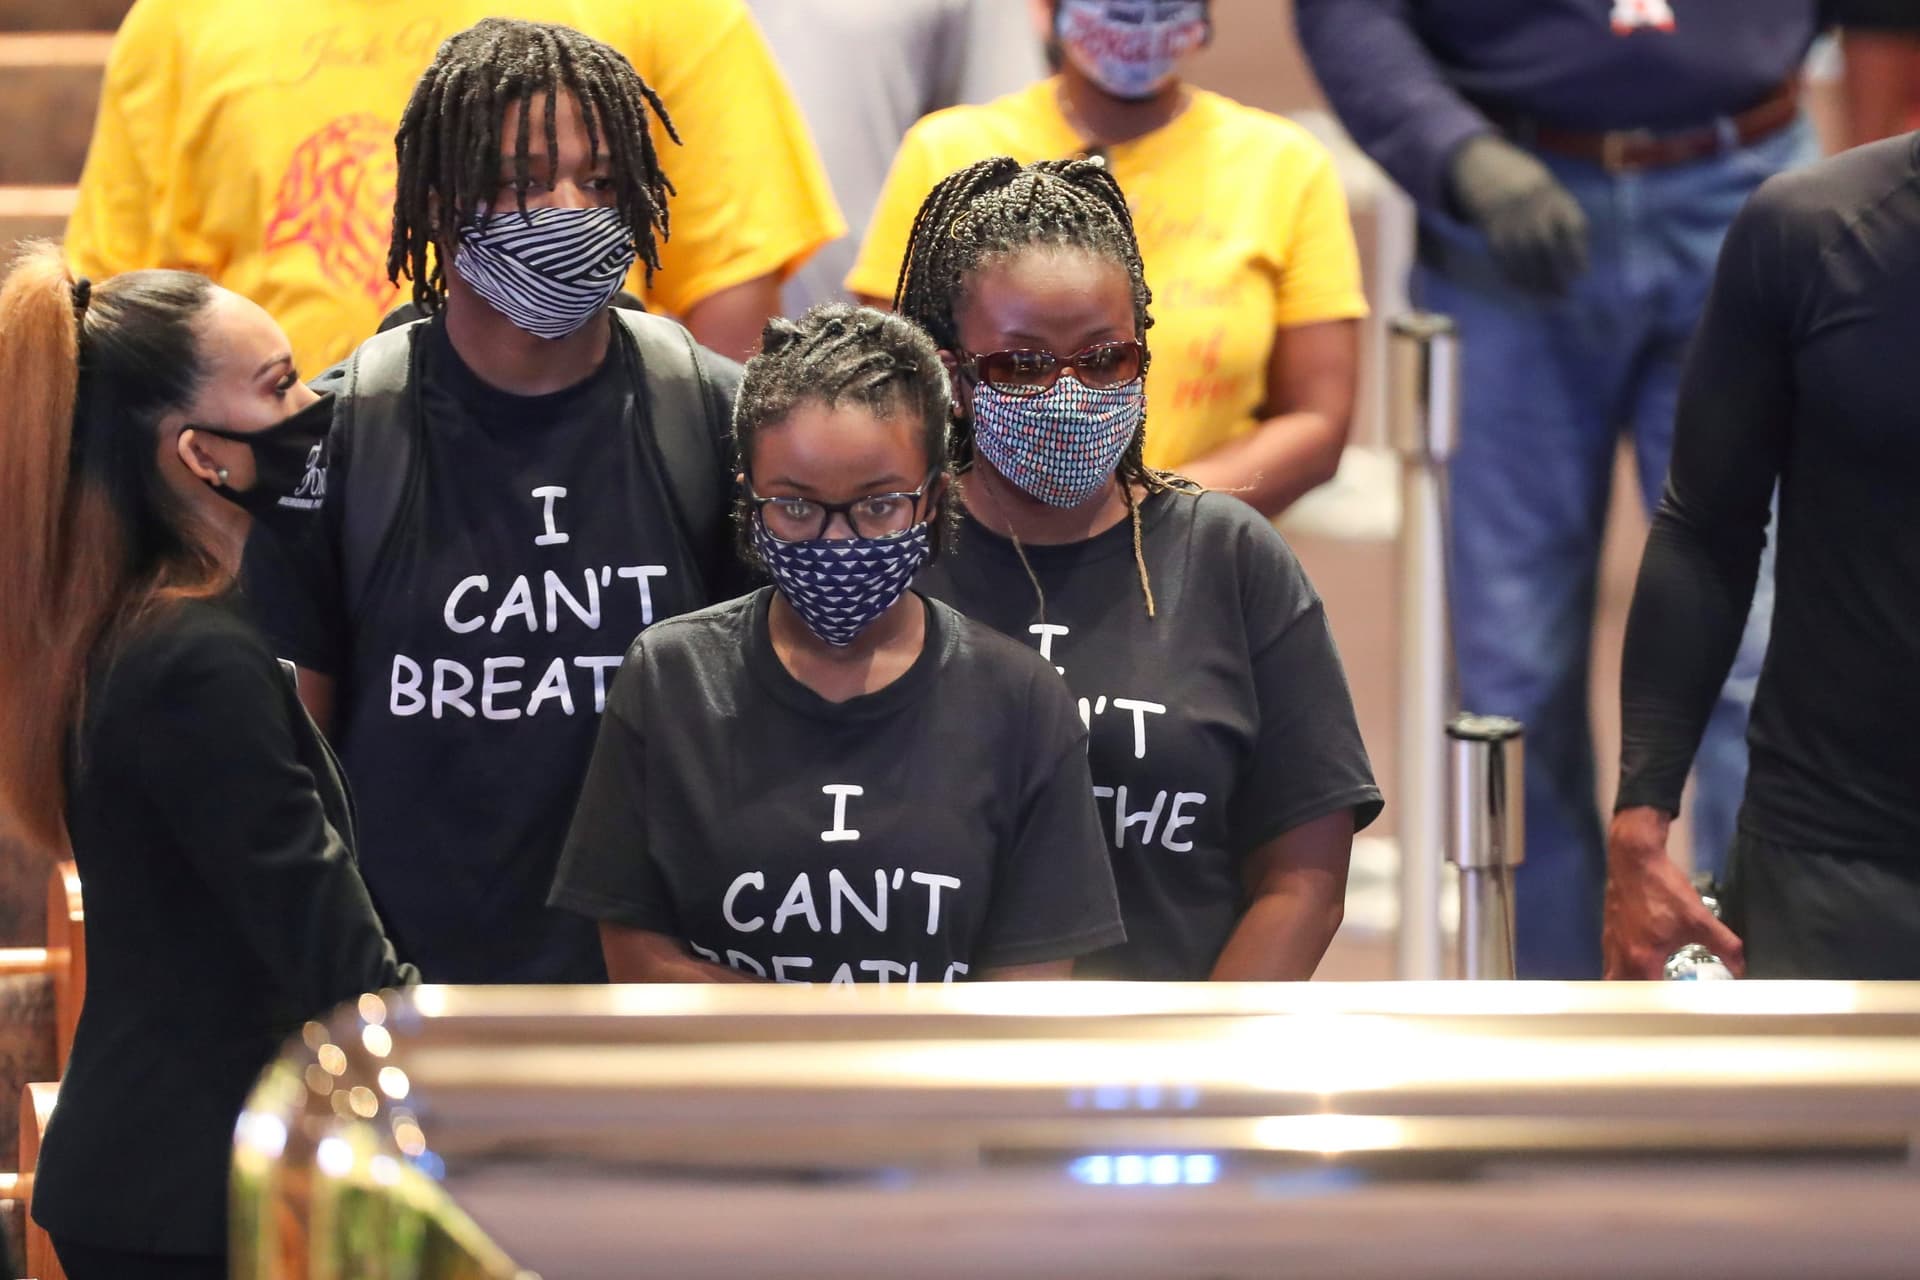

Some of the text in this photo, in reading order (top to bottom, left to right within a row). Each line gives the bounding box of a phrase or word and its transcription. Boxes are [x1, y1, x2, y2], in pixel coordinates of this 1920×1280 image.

[531, 485, 570, 546] I
[443, 565, 668, 634] CAN'T
[389, 653, 625, 720] BREAT
[820, 783, 865, 843] I
[722, 867, 962, 936] CAN'T
